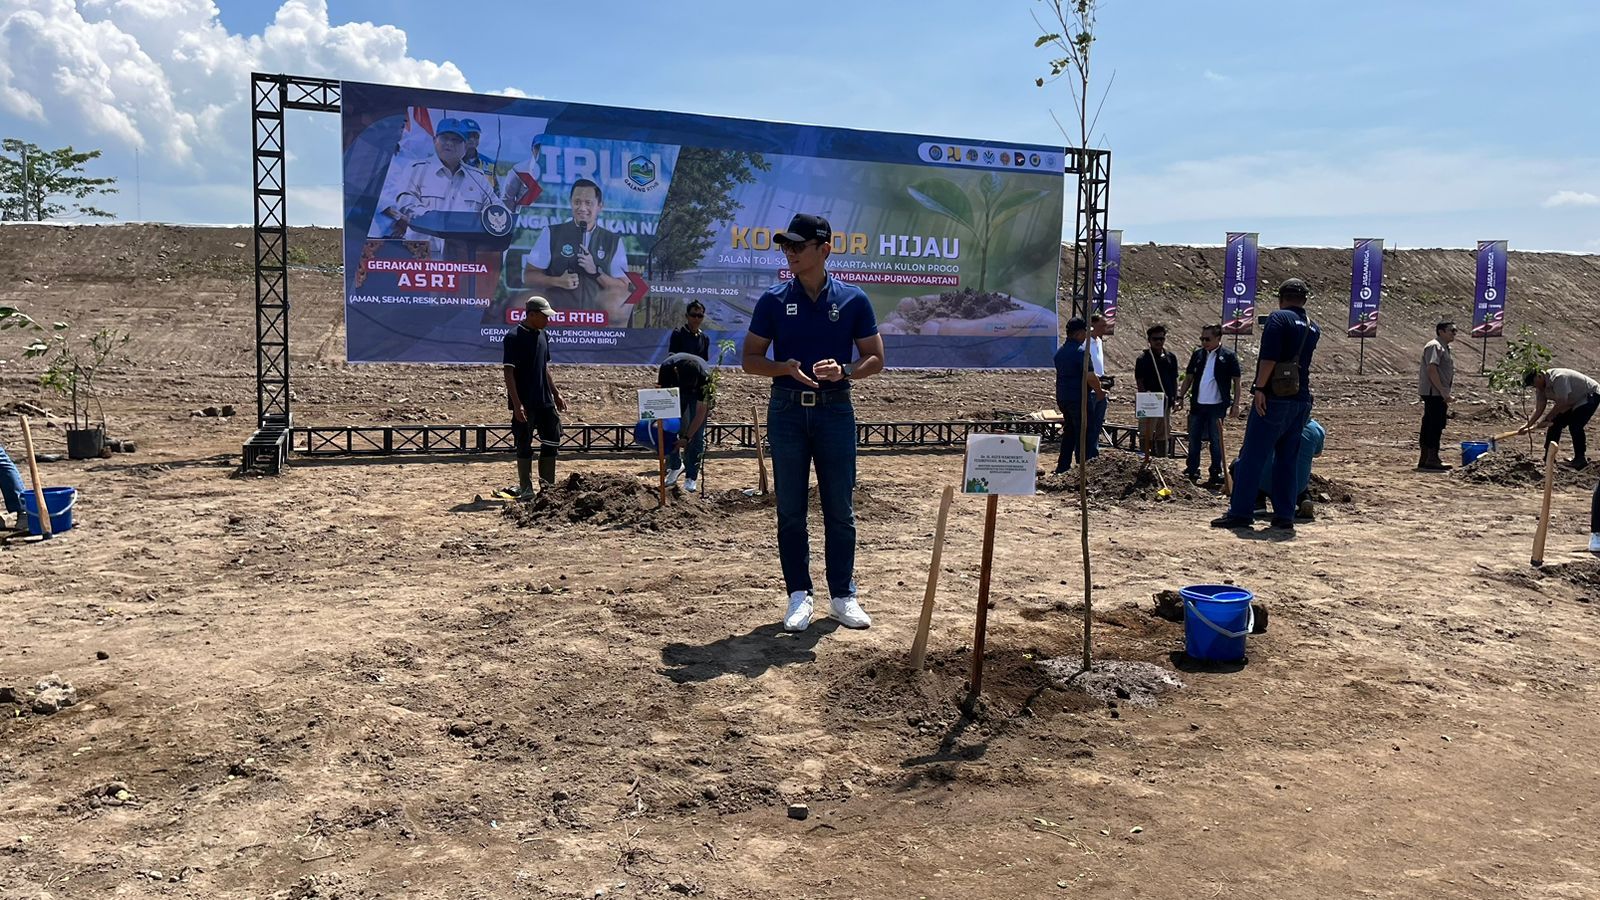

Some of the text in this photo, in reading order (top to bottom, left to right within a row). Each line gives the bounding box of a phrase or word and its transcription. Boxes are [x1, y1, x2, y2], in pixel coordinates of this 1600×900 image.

[731, 225, 960, 259] KOOR HIJAU
[367, 260, 488, 273] GERAKAN INDONESIA
[718, 255, 751, 264] JALAN
[753, 256, 773, 265] TOL
[894, 263, 926, 271] KULON
[927, 264, 960, 273] PROGO
[397, 273, 456, 288] ASRI
[829, 272, 958, 285] RAMBANAN-PURWOMARTANI
[650, 285, 739, 296] SLEMAN, 25 APRIL 2026
[349, 295, 490, 307] (AMAN, SEHAT, RESIK, DAN INDAH)
[510, 310, 605, 323] GANG RTHB
[562, 330, 626, 338] PENGEMBANGAN
[597, 338, 618, 346] BIRU)
